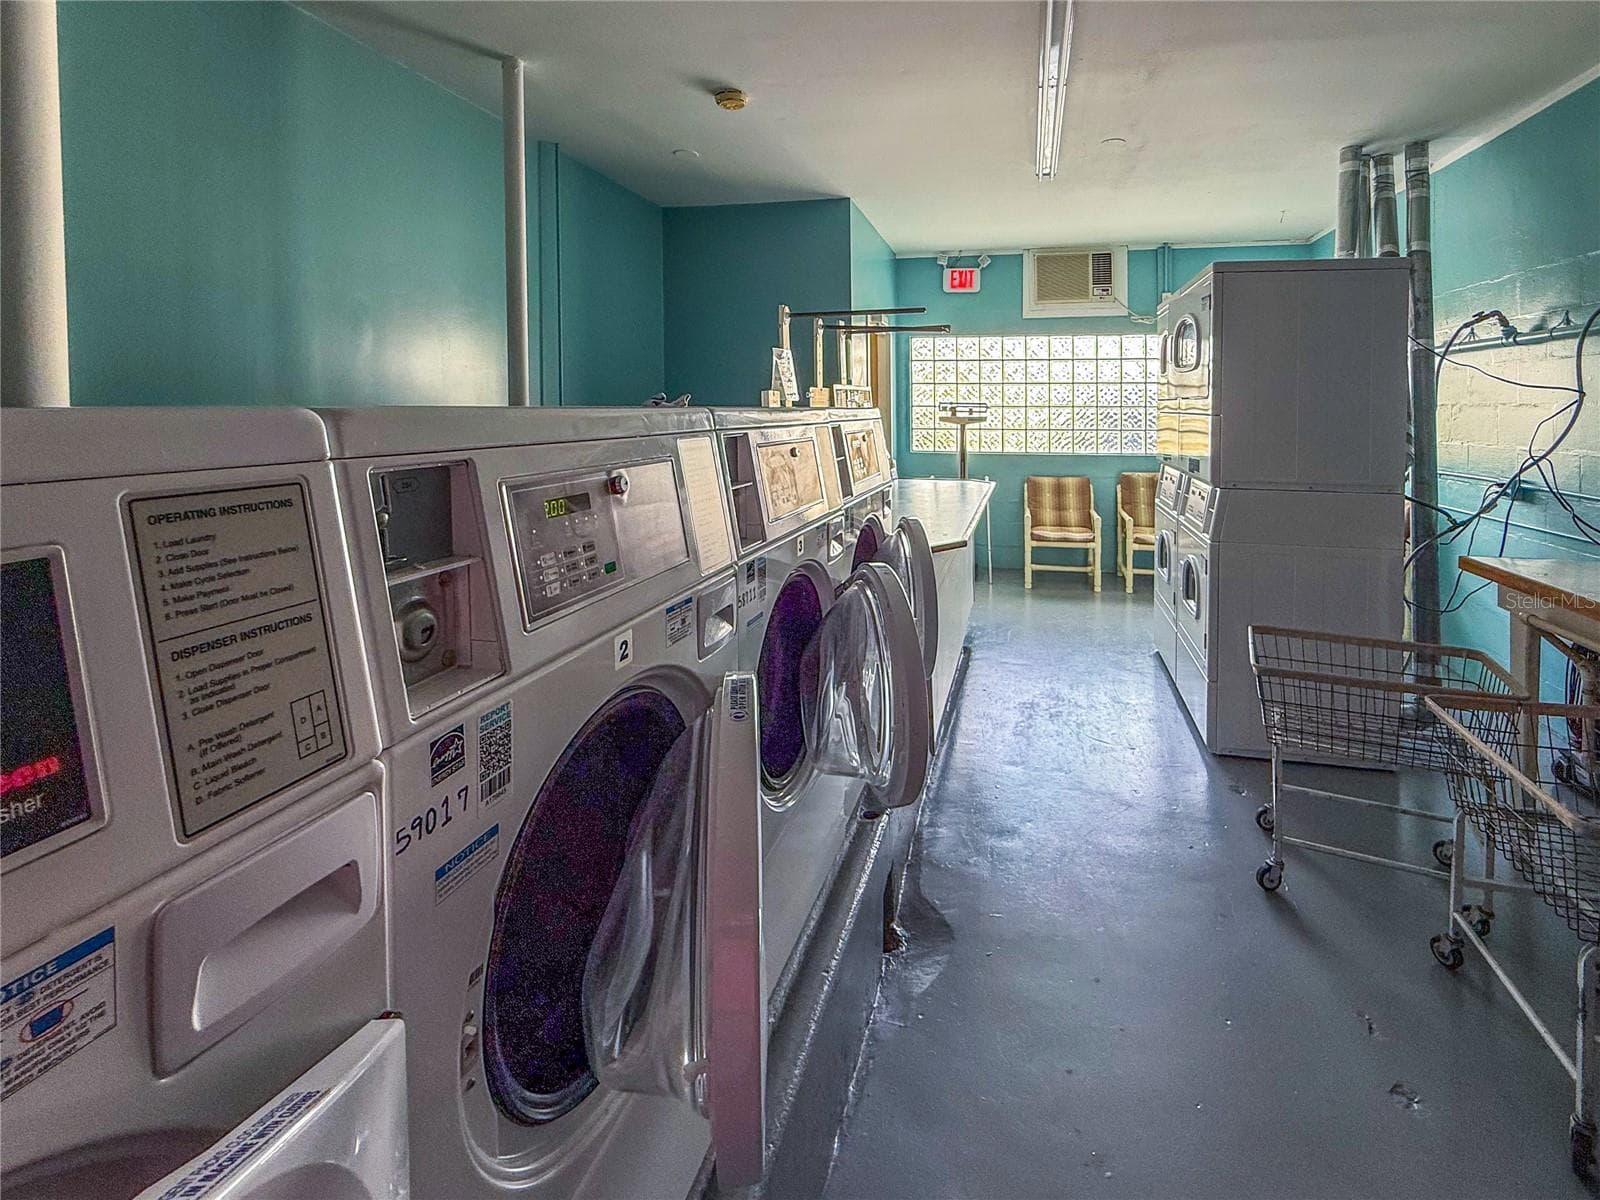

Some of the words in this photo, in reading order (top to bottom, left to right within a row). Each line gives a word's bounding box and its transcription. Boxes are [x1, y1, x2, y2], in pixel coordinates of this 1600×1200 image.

[951, 270, 975, 289] EXIT
[147, 508, 216, 526] OPERATING
[219, 499, 293, 517] INSTRUCTIONS
[163, 537, 184, 549] Load
[185, 533, 216, 546] Laundry
[190, 549, 209, 560] Door
[167, 566, 184, 576] Add
[186, 560, 219, 575] Supplies
[220, 556, 238, 567] (See
[238, 550, 276, 563] Instructions
[170, 580, 193, 590] Make
[194, 575, 216, 586] Cycle
[217, 568, 250, 581] Selection
[172, 595, 195, 605] Make
[196, 586, 230, 601] Payment
[175, 608, 199, 619] Press
[200, 601, 219, 612] Start
[220, 596, 239, 609] (Door
[240, 590, 259, 602] Must
[170, 634, 238, 663] DISPENSER
[240, 613, 313, 643] INSTRUCTIONS
[619, 639, 629, 662] 2
[184, 667, 208, 682] Open
[209, 654, 246, 675] Dispenser
[247, 649, 264, 660] Door
[187, 683, 208, 696] Load
[209, 671, 242, 689] Supplies
[250, 660, 273, 676] Proper
[275, 646, 317, 666] Compartment
[191, 704, 215, 717] Close
[216, 690, 253, 708] Dispenser
[253, 683, 271, 695] Door
[316, 704, 322, 712] A
[480, 702, 511, 724] REPORT
[198, 737, 214, 748] Pre
[215, 728, 239, 740] Wash
[239, 711, 275, 731] Detergent
[479, 711, 512, 734] SERVICE
[202, 760, 223, 773] Main
[224, 750, 247, 763] Wash
[247, 731, 283, 752] Detergent
[210, 735, 242, 753] Offered)
[305, 743, 312, 751] C
[204, 771, 229, 785] Liquid
[231, 757, 257, 774] Bleach
[207, 784, 233, 800] Fabric
[234, 767, 266, 788] Softener
[395, 785, 470, 857] 59017
[444, 833, 494, 873] NOTICE
[16, 999, 41, 1018] BEST
[43, 959, 110, 1001] PERFORMANCE
[40, 959, 93, 995] DETERGENT
[80, 1000, 106, 1019] AVOID
[198, 1141, 260, 1183] MACHINE
[251, 1119, 286, 1141] WITH
